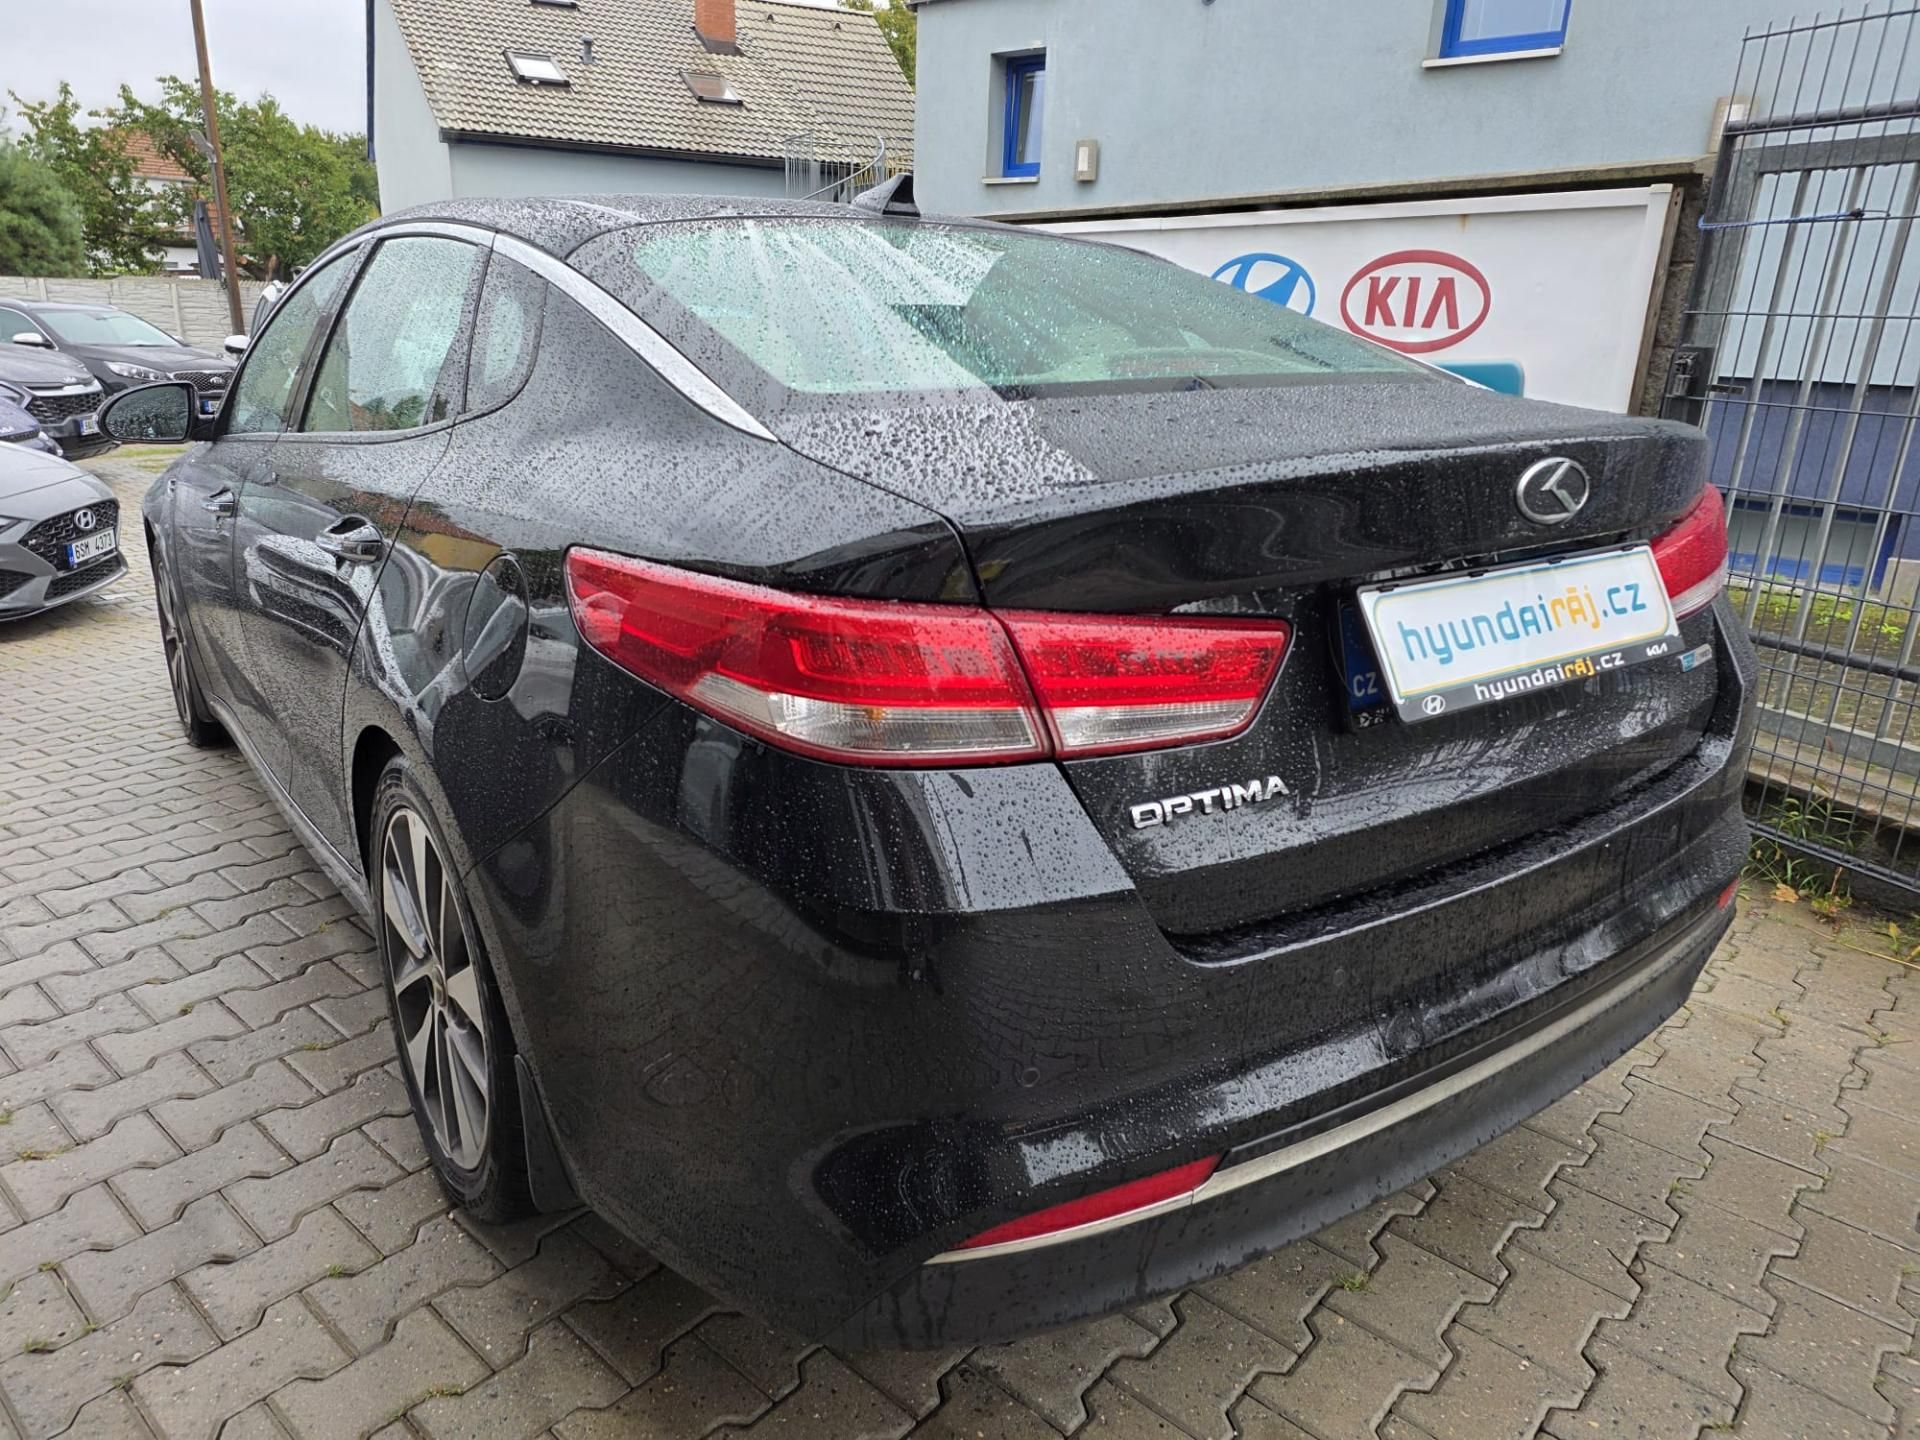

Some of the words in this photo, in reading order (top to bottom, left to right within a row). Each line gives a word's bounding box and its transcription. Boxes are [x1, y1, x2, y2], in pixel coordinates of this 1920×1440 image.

[1363, 275, 1460, 330] KIA
[1645, 642, 1669, 657] KIA
[1352, 671, 1379, 697] CZ
[1129, 775, 1291, 830] OPTIMA
